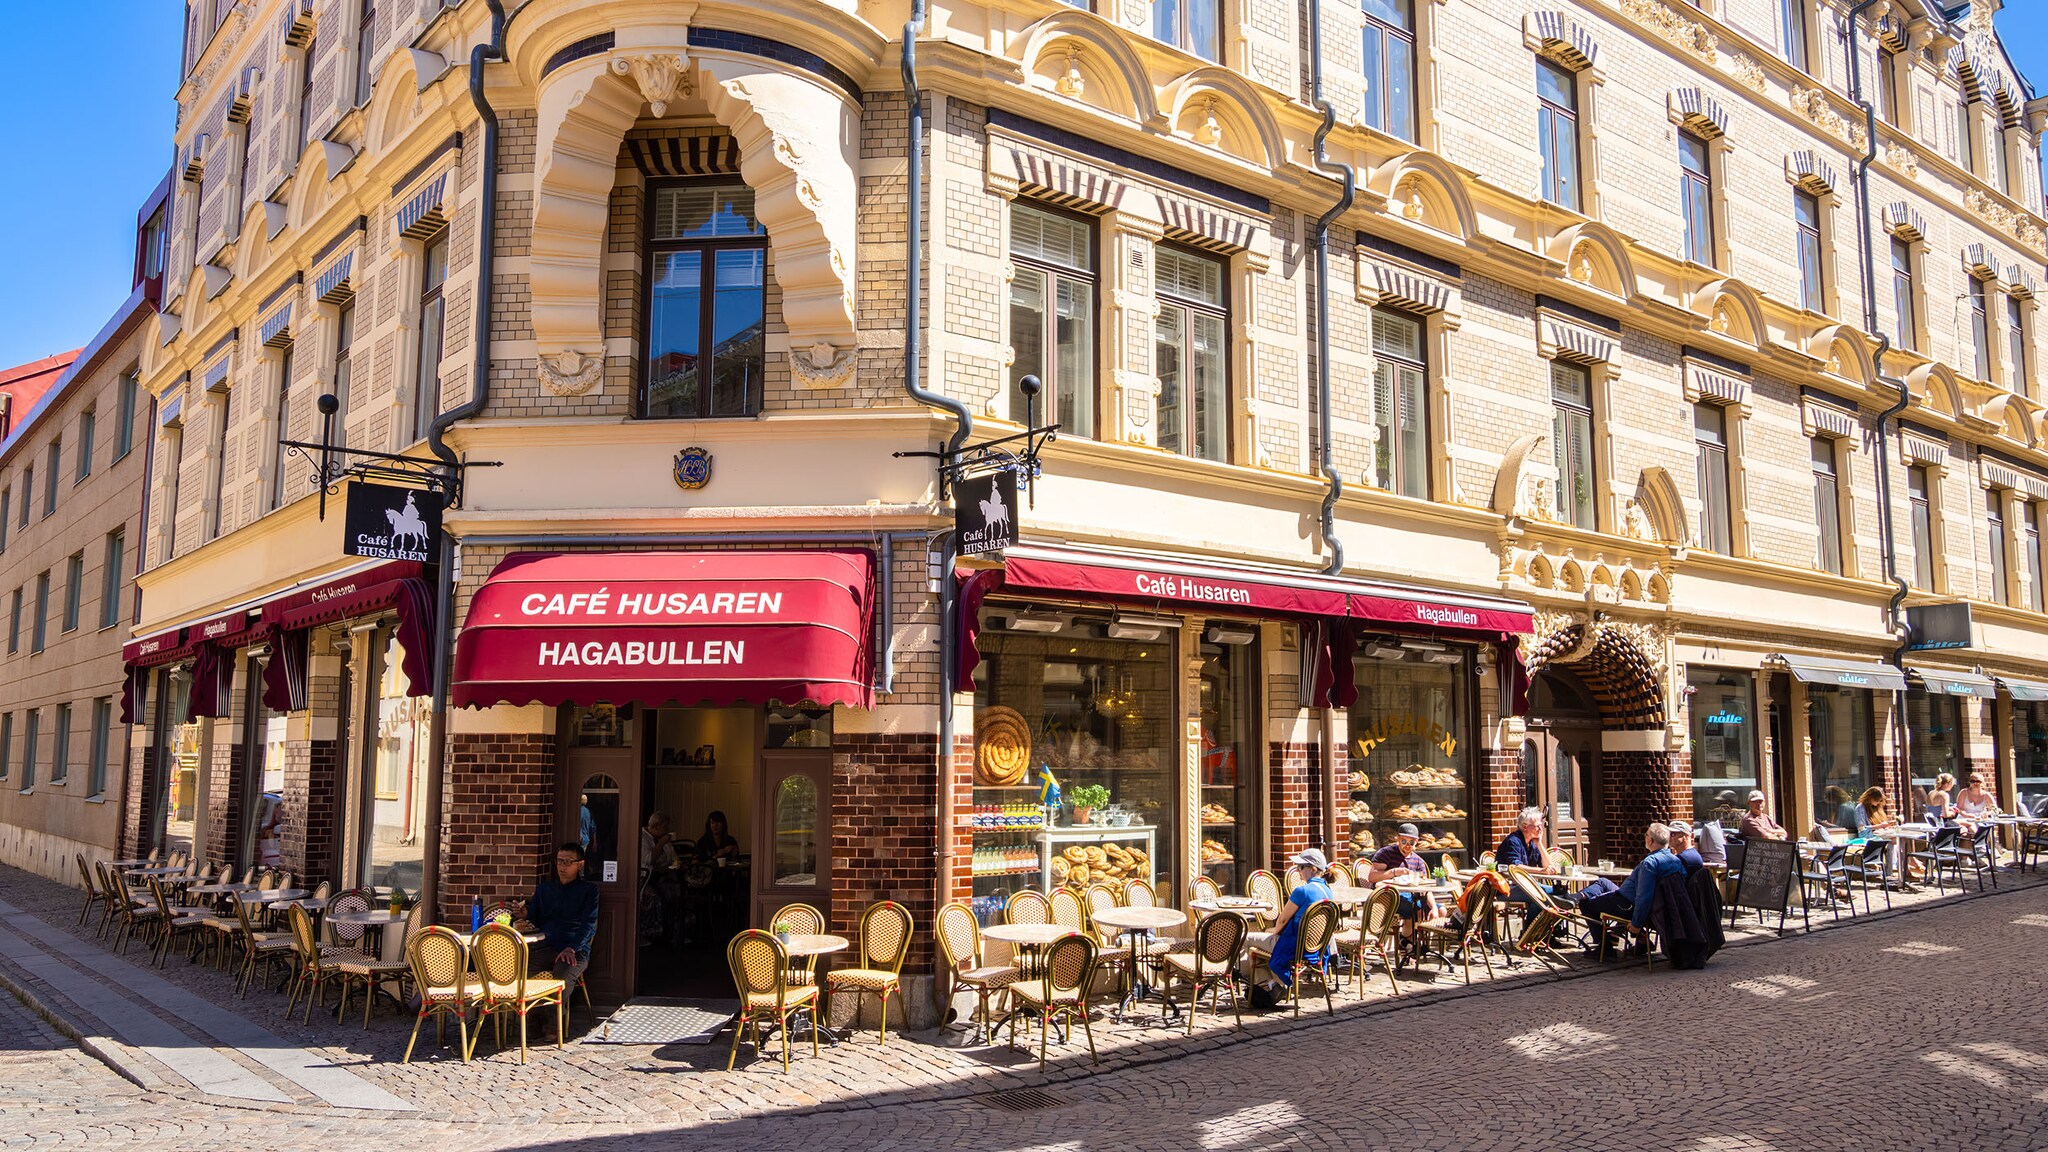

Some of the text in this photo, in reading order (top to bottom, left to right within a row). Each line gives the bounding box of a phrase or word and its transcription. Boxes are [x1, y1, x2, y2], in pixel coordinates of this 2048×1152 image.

[357, 533, 388, 546] Café
[963, 528, 983, 542] Café
[356, 545, 428, 562] HUSAREN
[963, 537, 1011, 554] HUSAREN
[311, 583, 357, 604] Café Husaren
[1135, 574, 1251, 603] Café Husaren
[520, 587, 783, 616] CAFÉ HUSAREN
[1416, 604, 1478, 624] Hagabullen
[204, 621, 227, 638] Hagabullen
[538, 640, 745, 666] HAGABULLEN
[1357, 711, 1457, 759] HUSAREN
